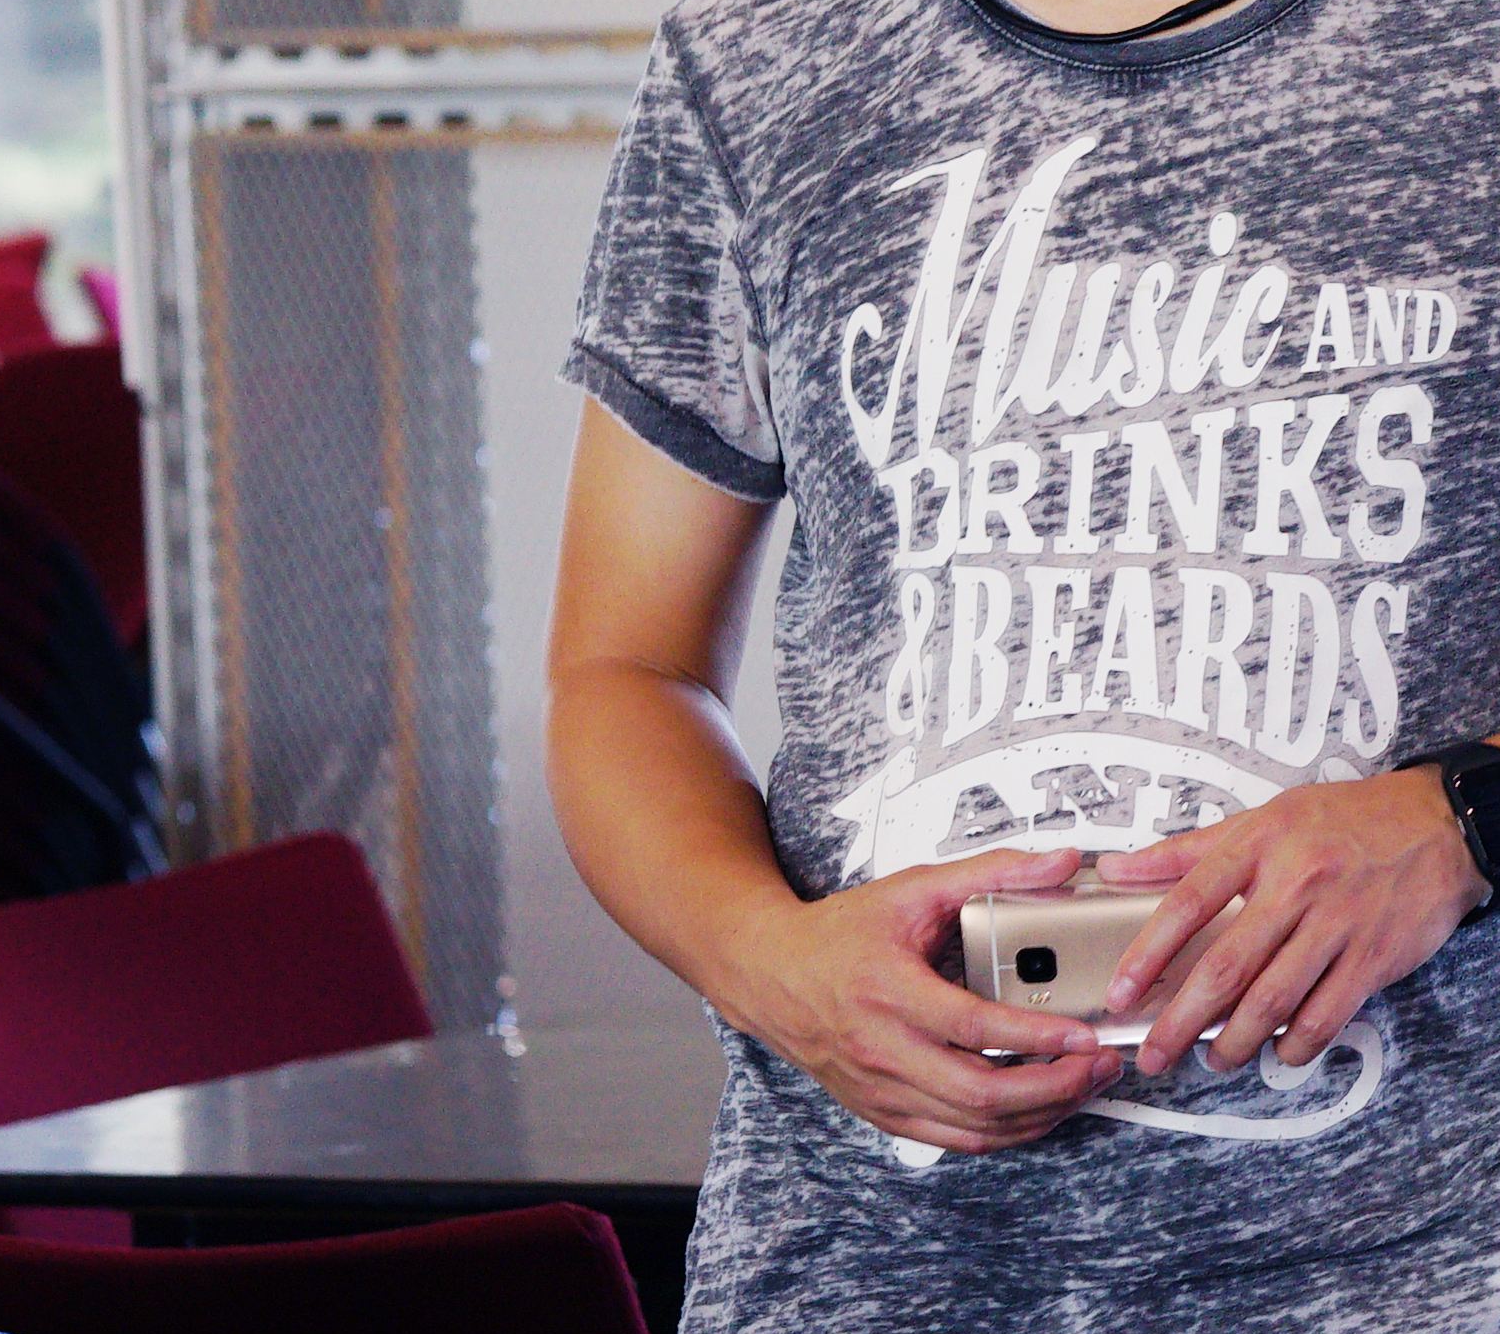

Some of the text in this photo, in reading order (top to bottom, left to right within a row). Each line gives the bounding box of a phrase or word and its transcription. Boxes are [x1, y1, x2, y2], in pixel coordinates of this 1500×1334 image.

[841, 136, 1458, 464] Music AND
[876, 382, 1435, 569] DRINKS
